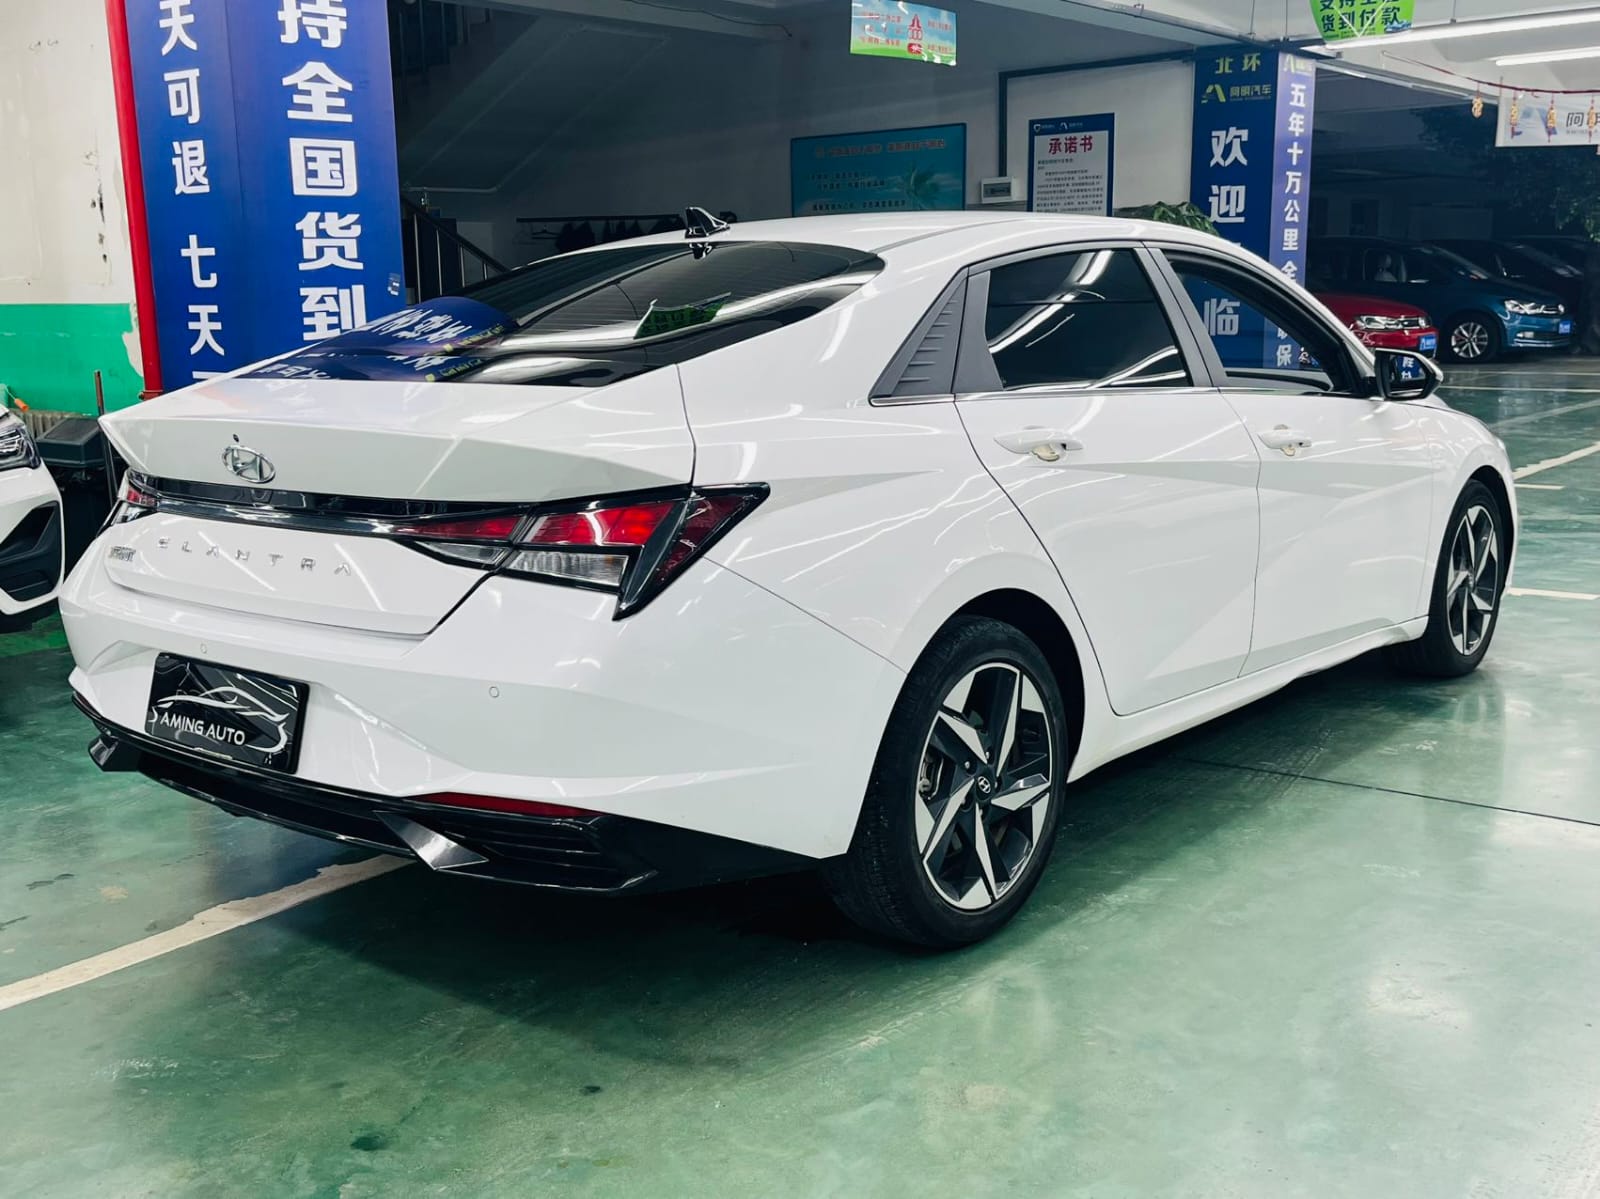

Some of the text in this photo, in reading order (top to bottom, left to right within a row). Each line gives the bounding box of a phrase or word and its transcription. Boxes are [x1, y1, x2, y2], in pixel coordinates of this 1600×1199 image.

[1321, 6, 1400, 32] 货到付款
[1215, 53, 1261, 74] 北环
[1048, 135, 1093, 155] 承诺书
[157, 537, 352, 577] ELANTRA
[160, 711, 246, 746] AMING AUTO
